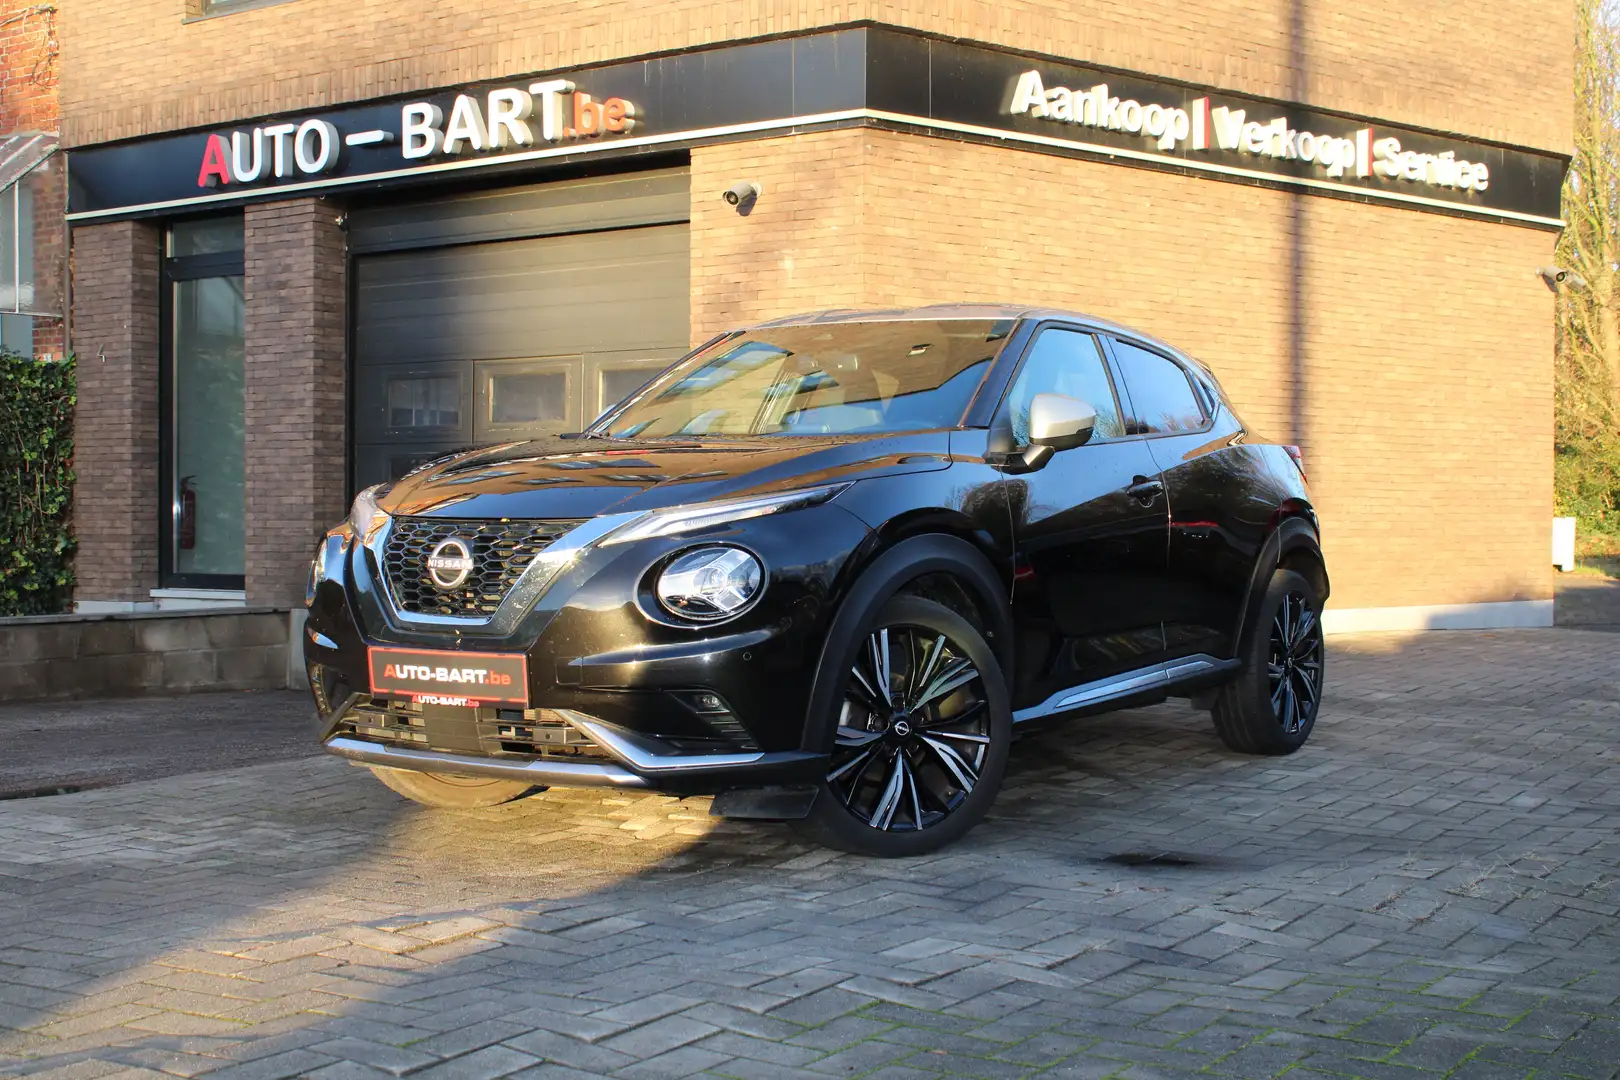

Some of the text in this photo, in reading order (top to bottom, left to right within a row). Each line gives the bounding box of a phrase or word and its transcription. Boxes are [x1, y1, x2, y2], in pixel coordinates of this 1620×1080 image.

[199, 118, 337, 188] AUTO
[402, 79, 630, 160] BART.be
[1010, 69, 1489, 192] Aankoop Verkoop Service
[428, 558, 472, 569] NISSAN
[383, 663, 511, 685] AUTO-BART.be
[412, 695, 480, 707] AUTO-BART.be
